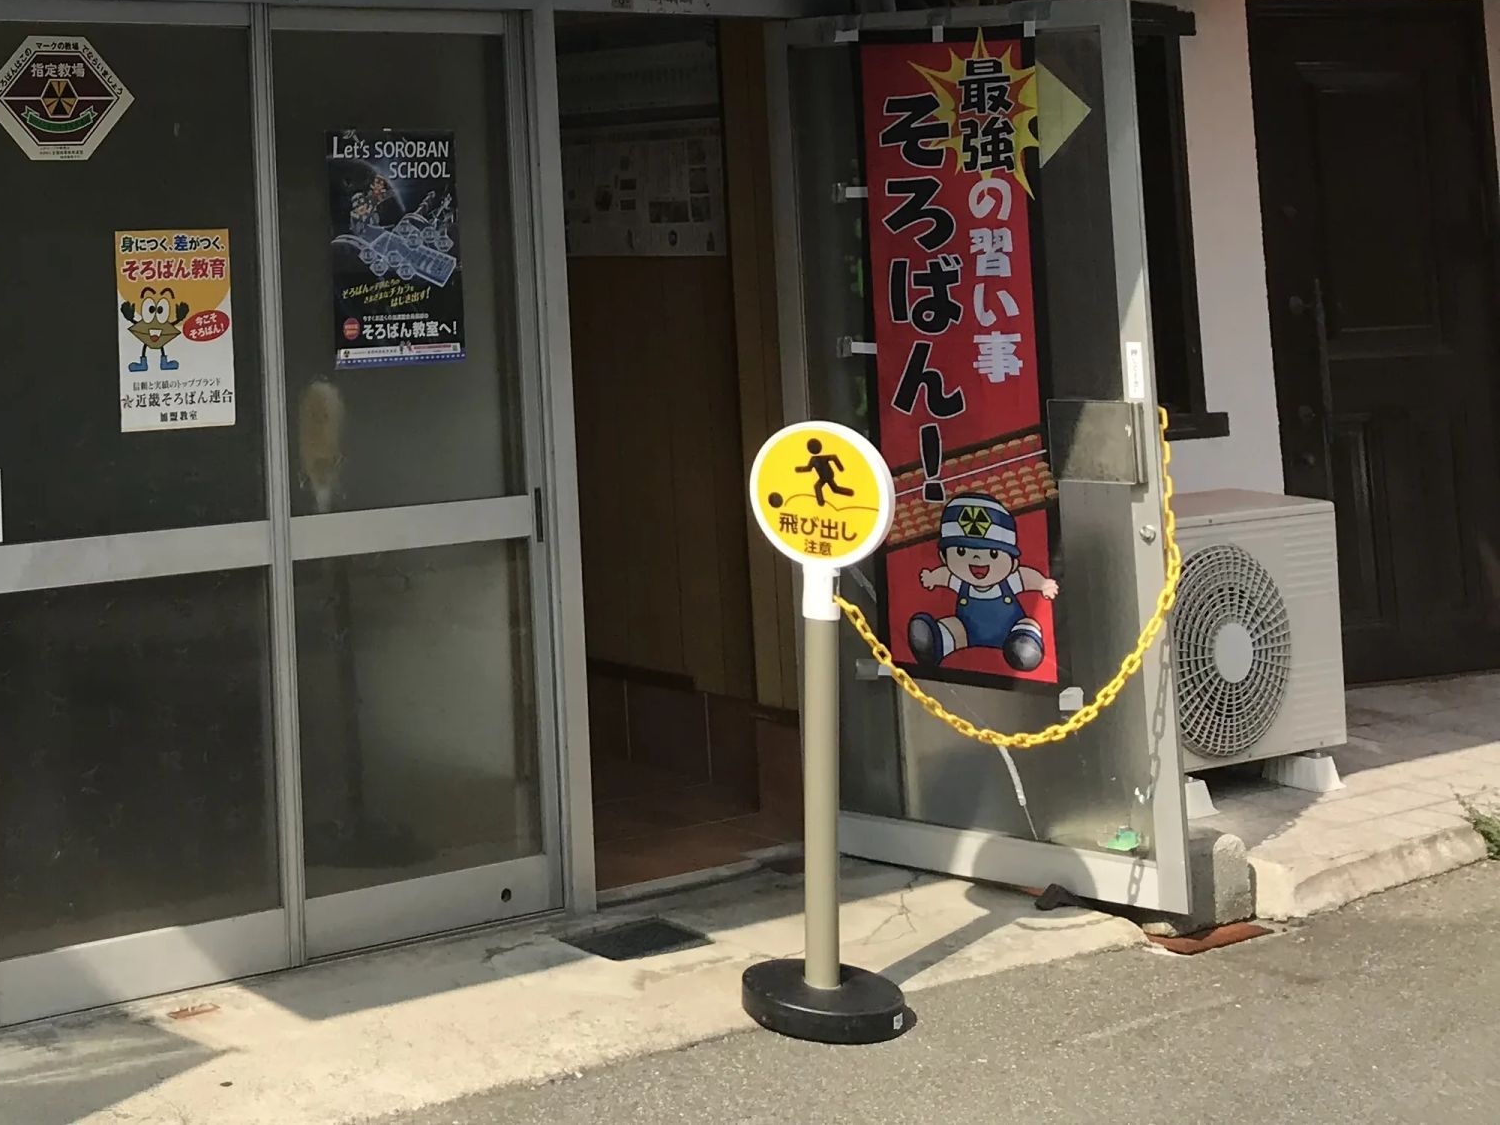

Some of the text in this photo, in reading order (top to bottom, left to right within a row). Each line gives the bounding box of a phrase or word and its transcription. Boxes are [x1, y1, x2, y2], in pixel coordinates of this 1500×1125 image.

[35, 41, 80, 50] マークの教場
[30, 62, 86, 78] 指定教場
[332, 136, 449, 159] Let's SOROBAN
[388, 161, 451, 179] SCHOOL
[957, 57, 1022, 385] 最強の習い事
[120, 235, 225, 253] 身につく、差がつく、
[122, 258, 226, 281] そろばん教育
[878, 93, 966, 502] そろばん!
[195, 312, 218, 326] 今こそ
[188, 322, 225, 339] そろばん!
[362, 320, 458, 340] そろばん教室へ!
[135, 389, 234, 408] 近畿そろばん連合
[159, 409, 198, 423] 加盟教室
[778, 511, 858, 542] 飛び出し
[804, 538, 833, 557] 注意
